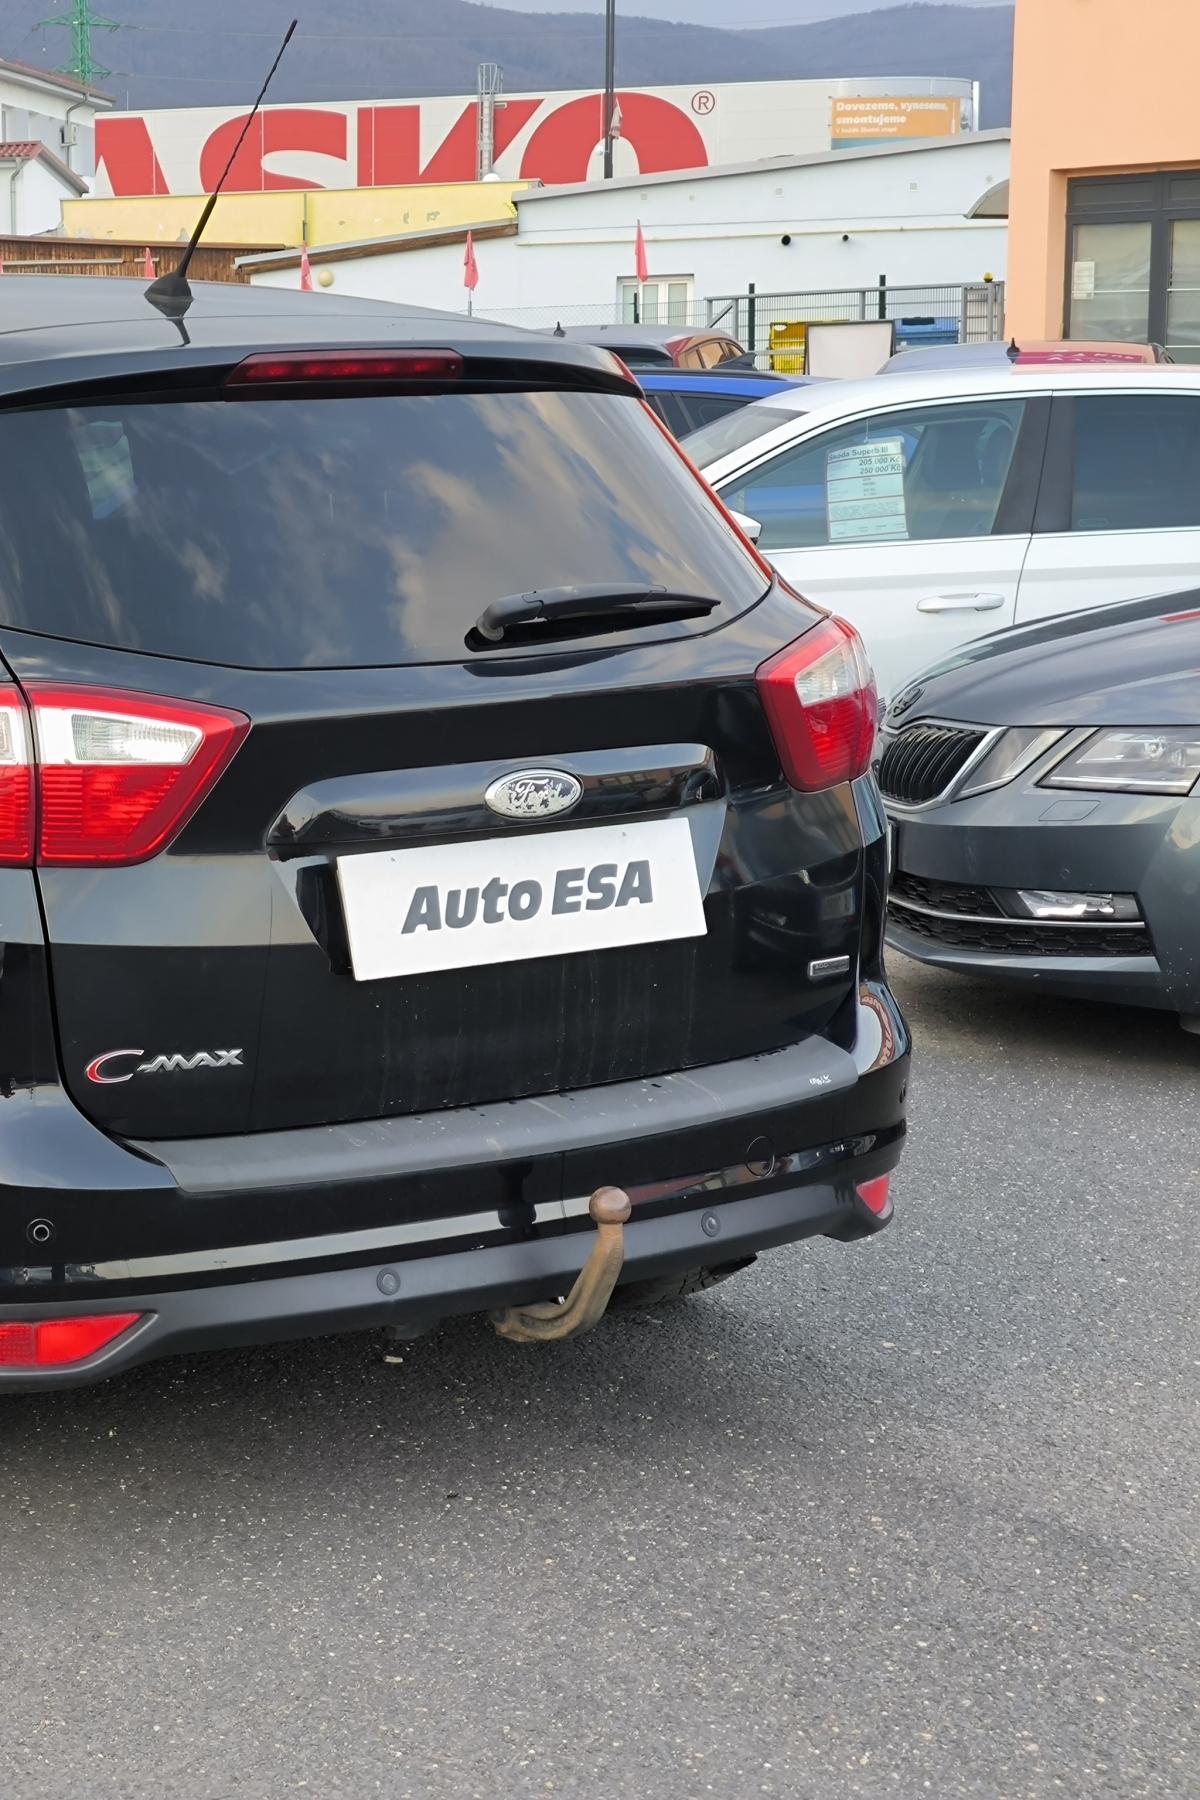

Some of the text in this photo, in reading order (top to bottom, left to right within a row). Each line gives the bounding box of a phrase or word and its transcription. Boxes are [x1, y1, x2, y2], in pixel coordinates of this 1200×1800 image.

[836, 114, 906, 125] smontujeme
[401, 859, 653, 934] Auto ESA
